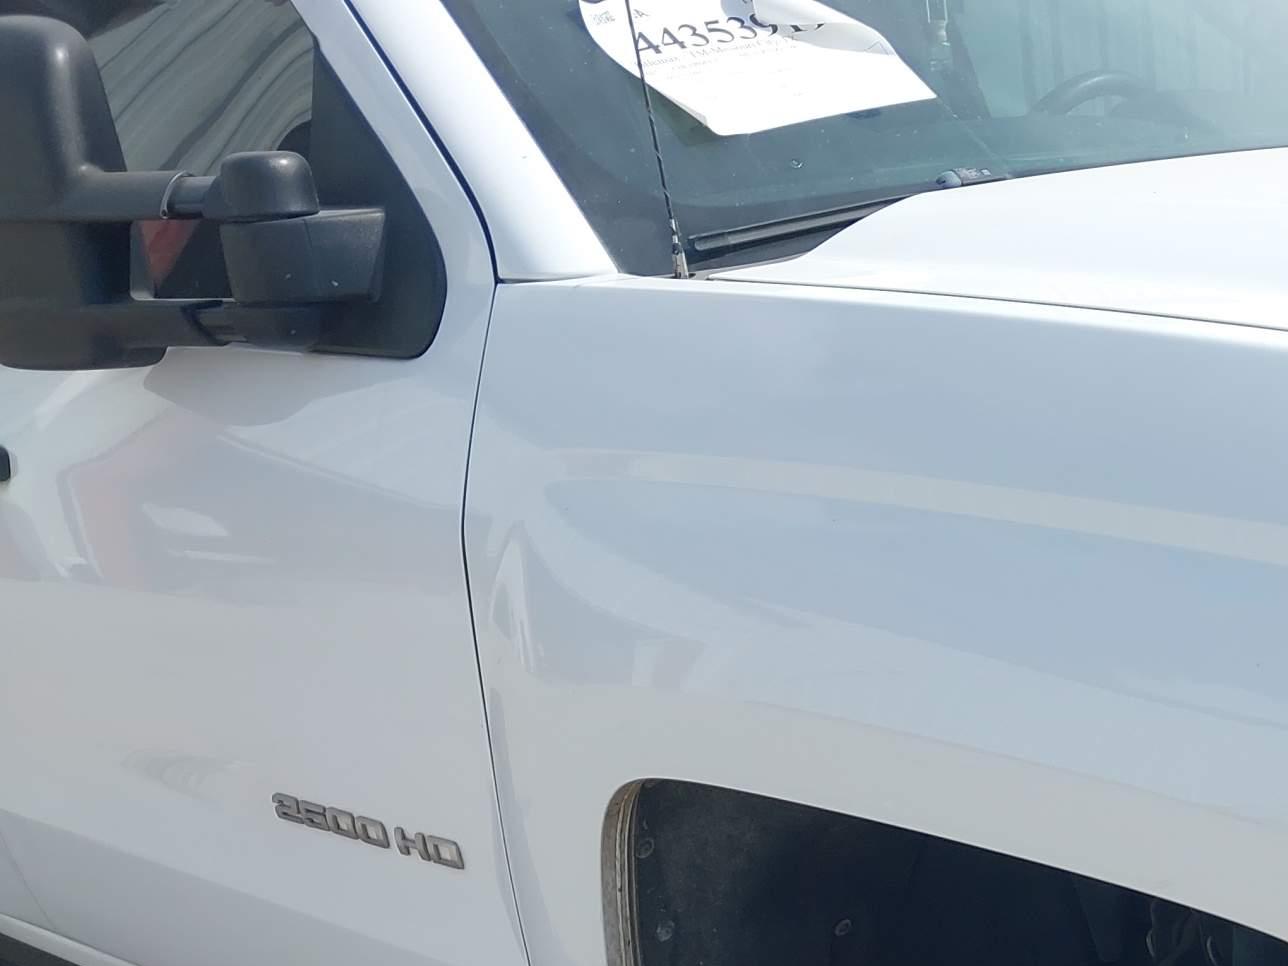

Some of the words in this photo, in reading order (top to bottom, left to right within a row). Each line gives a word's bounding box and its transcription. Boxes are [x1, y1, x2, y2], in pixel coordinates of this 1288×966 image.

[635, 13, 825, 54] 443539
[272, 792, 390, 849] 2500
[394, 826, 465, 869] HD
